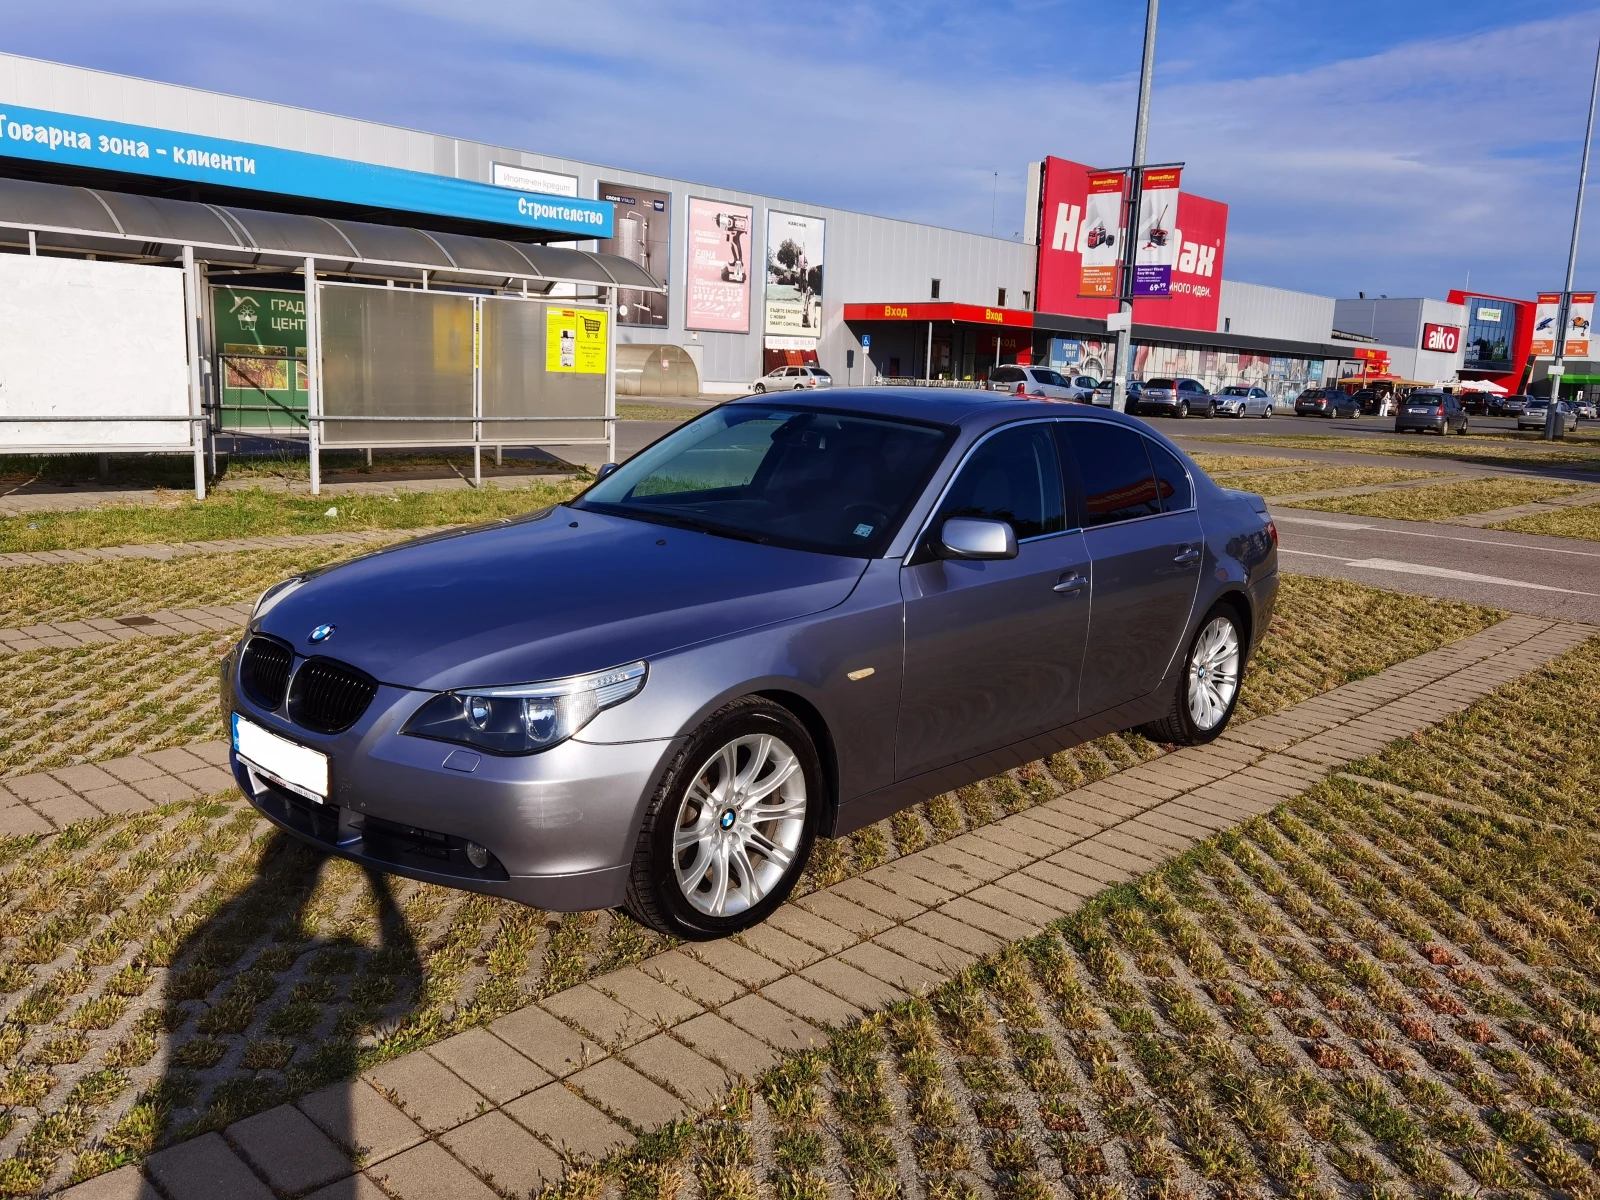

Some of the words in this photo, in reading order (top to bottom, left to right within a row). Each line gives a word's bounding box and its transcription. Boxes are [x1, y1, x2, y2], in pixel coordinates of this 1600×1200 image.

[98, 135, 149, 158] зона
[173, 146, 256, 174] клиенти
[503, 173, 542, 187] Ипотечен
[543, 179, 571, 192] кредит
[518, 197, 603, 225] Строителство
[695, 249, 716, 260] ЕДНА
[884, 305, 908, 318] Вход
[985, 308, 1003, 322] Вход
[1428, 326, 1455, 350] aiko
